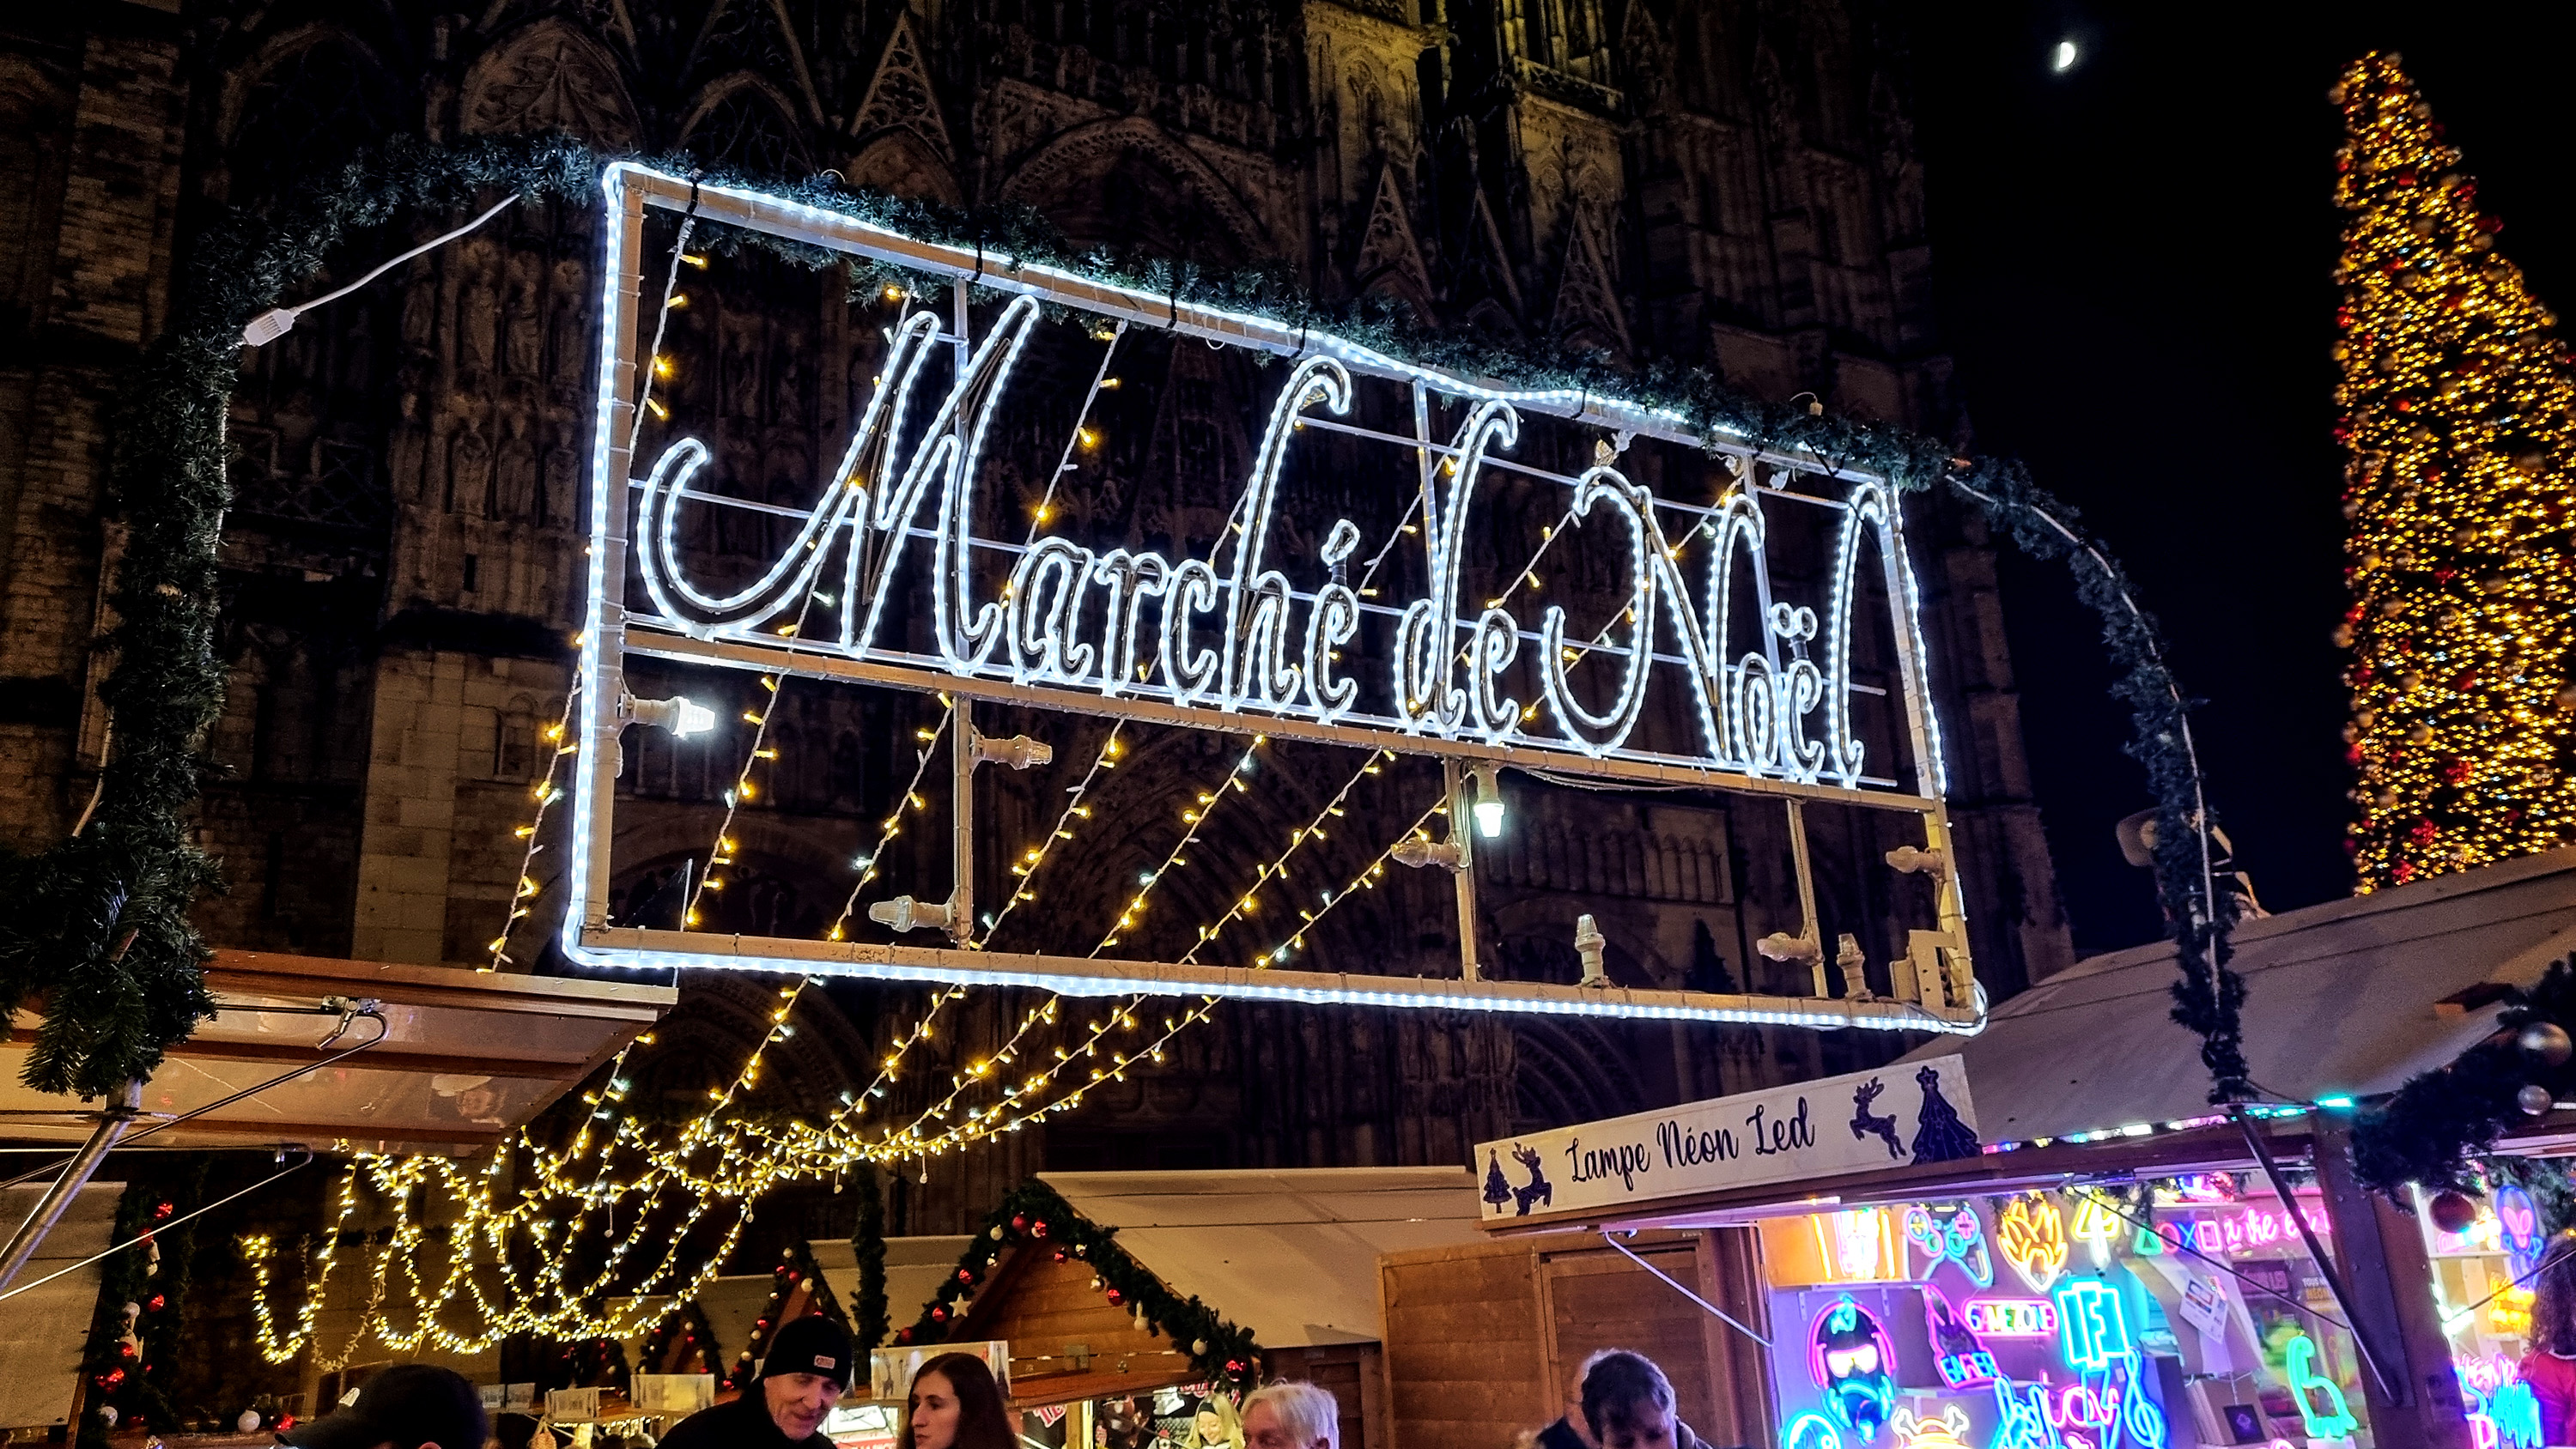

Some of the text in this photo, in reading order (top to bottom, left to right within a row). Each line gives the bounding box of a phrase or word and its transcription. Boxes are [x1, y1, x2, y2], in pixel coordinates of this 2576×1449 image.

[636, 294, 1888, 791] Marché de Noël
[1564, 1095, 1816, 1191] Lampe Néon Led
[1941, 1350, 2000, 1385] GAMER
